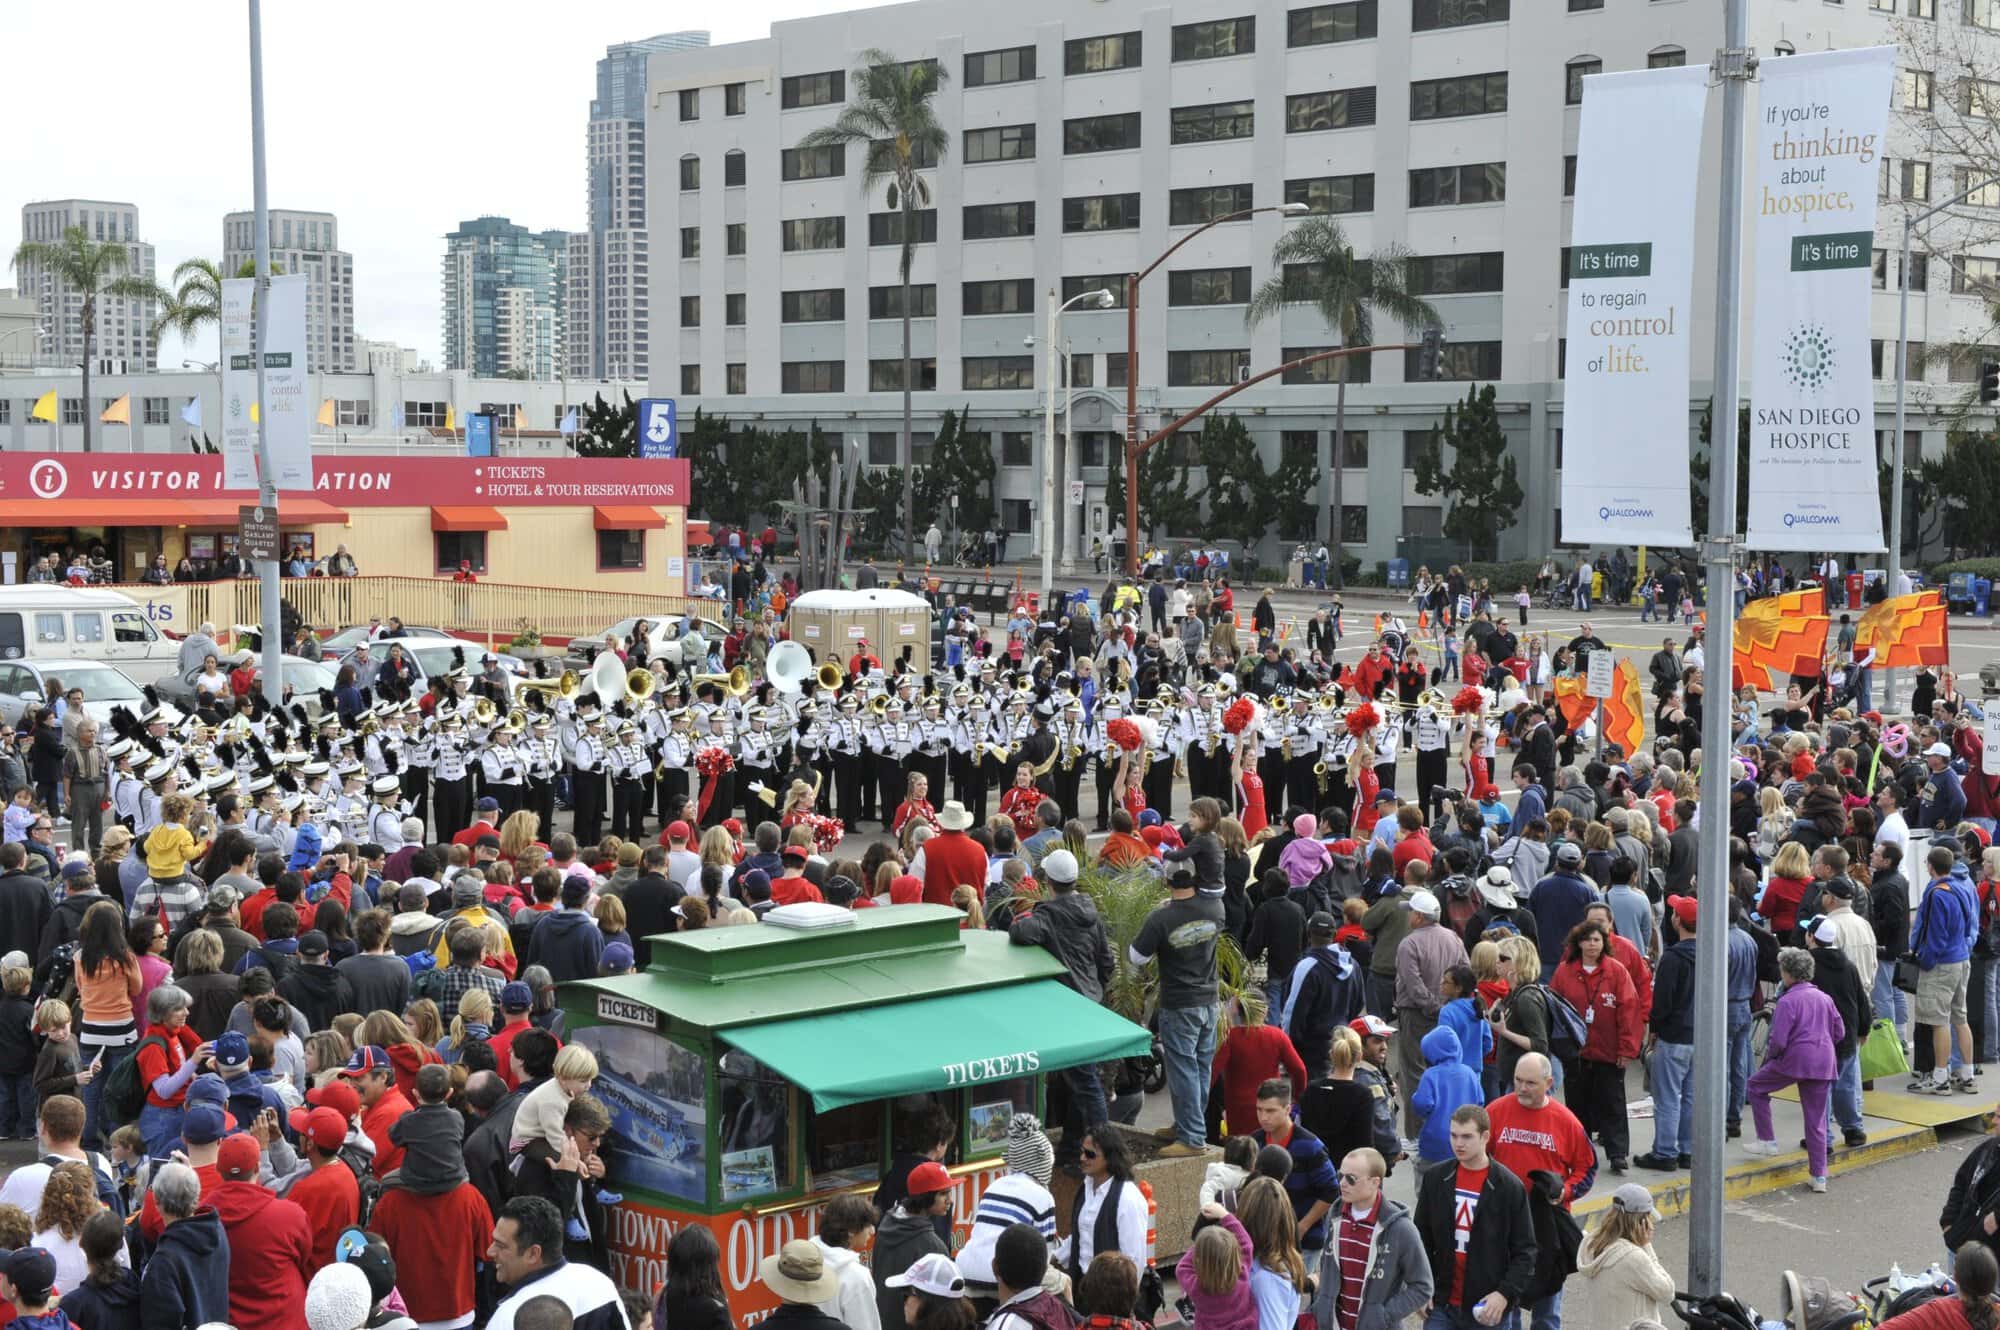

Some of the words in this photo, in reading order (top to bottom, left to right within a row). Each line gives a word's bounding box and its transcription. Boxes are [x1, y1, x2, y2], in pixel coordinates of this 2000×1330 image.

[1767, 106, 1777, 123] If
[1782, 103, 1829, 126] you're
[1773, 128, 1876, 163] thinking
[1781, 166, 1825, 184] about
[1762, 186, 1854, 222] hospice,
[1580, 253, 1600, 270] It's
[1605, 252, 1639, 269] time
[1802, 243, 1820, 261] It's
[1825, 242, 1858, 259] time
[1582, 293, 1595, 306] to
[1601, 289, 1646, 310] regain
[1591, 306, 1674, 336] control
[1588, 357, 1603, 373] of
[1608, 344, 1649, 373] life.
[1758, 408, 1792, 425] SAN
[1800, 408, 1860, 425] DIEGO
[1770, 433, 1850, 449] HOSPICE
[91, 470, 200, 489] VISITOR
[488, 467, 545, 478] TICKETS
[488, 485, 531, 496] HOTEL
[534, 485, 543, 496] &
[546, 485, 581, 496] TOUR
[583, 485, 674, 496] RESERVATIONS
[1599, 507, 1654, 521] QUALCOMM
[1783, 513, 1840, 527] QUALCOMM
[244, 531, 274, 539] GASLAMP
[244, 539, 274, 548] QUARTER
[600, 999, 655, 1023] TICKETS
[943, 1050, 1040, 1084] TICKETS
[1497, 1127, 1556, 1152] ARIZONA
